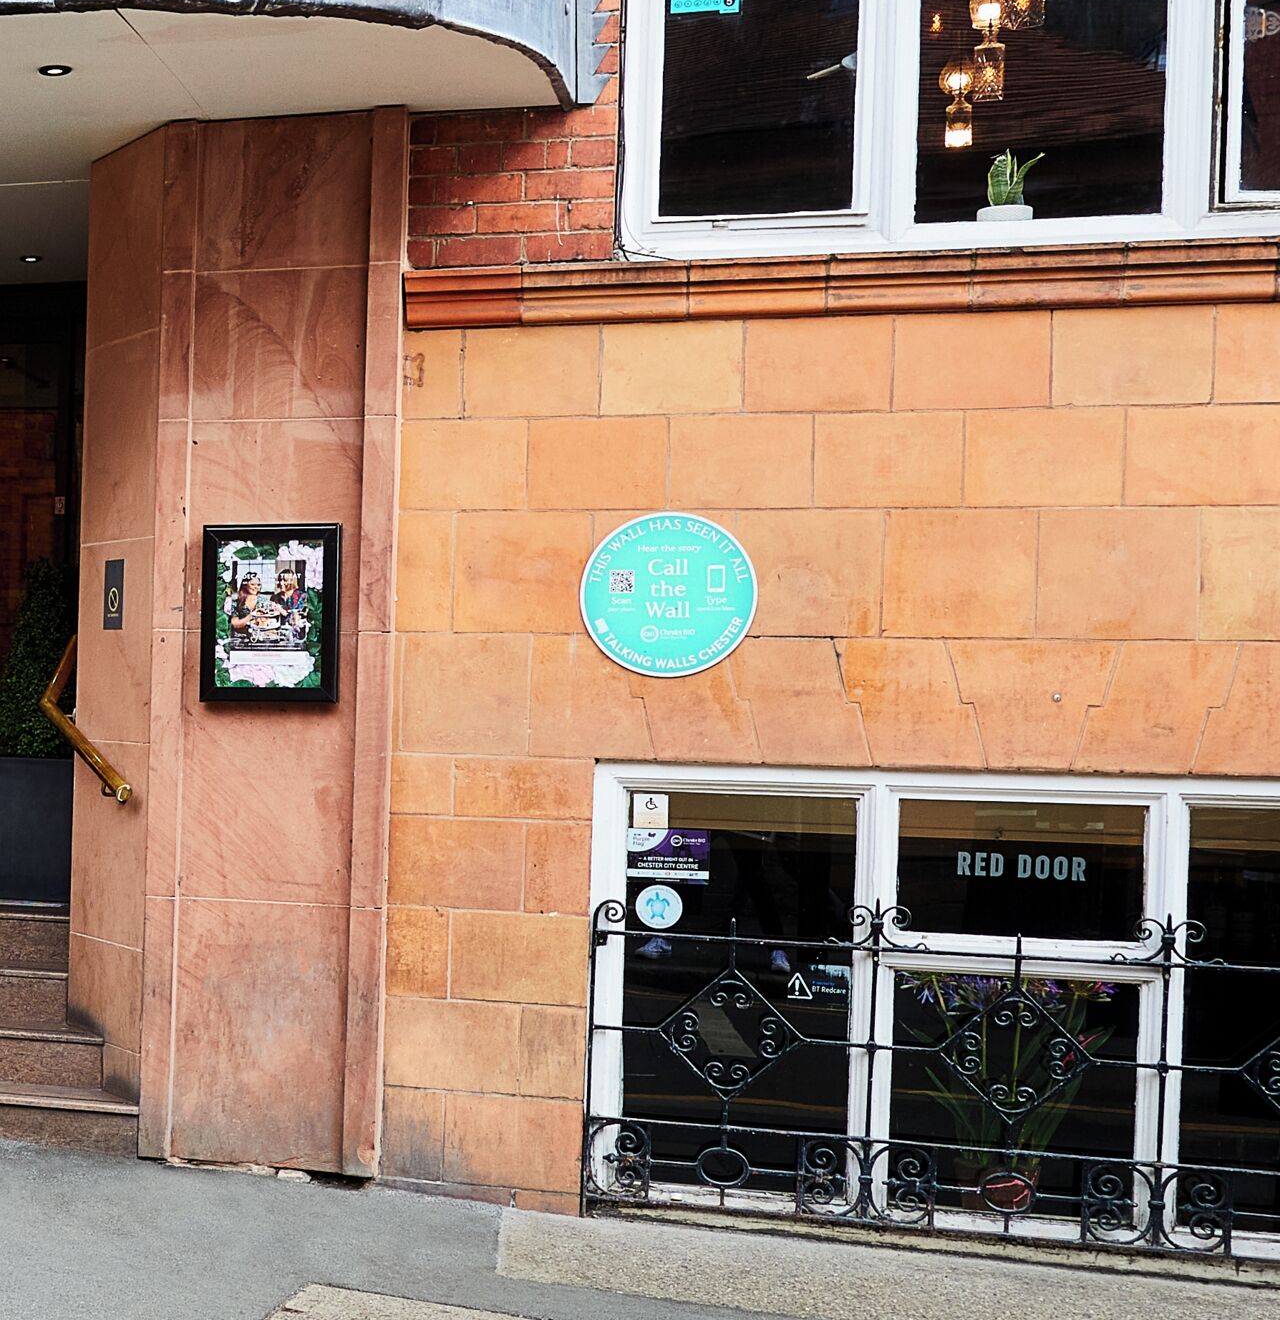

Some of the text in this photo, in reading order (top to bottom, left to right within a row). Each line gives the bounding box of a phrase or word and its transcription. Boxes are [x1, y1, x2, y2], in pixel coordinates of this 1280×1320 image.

[589, 518, 749, 584] THIS WALL HAS SEEN IT ALL
[638, 544, 702, 554] Hear the story
[647, 558, 689, 576] Call
[650, 580, 687, 597] the
[611, 596, 632, 605] Scan
[645, 600, 691, 618] Wall
[704, 595, 728, 606] Type
[604, 616, 744, 669] TALKING WALLS CHESTER
[956, 851, 1086, 881] RED DOOR
[821, 986, 847, 995] Redcare
